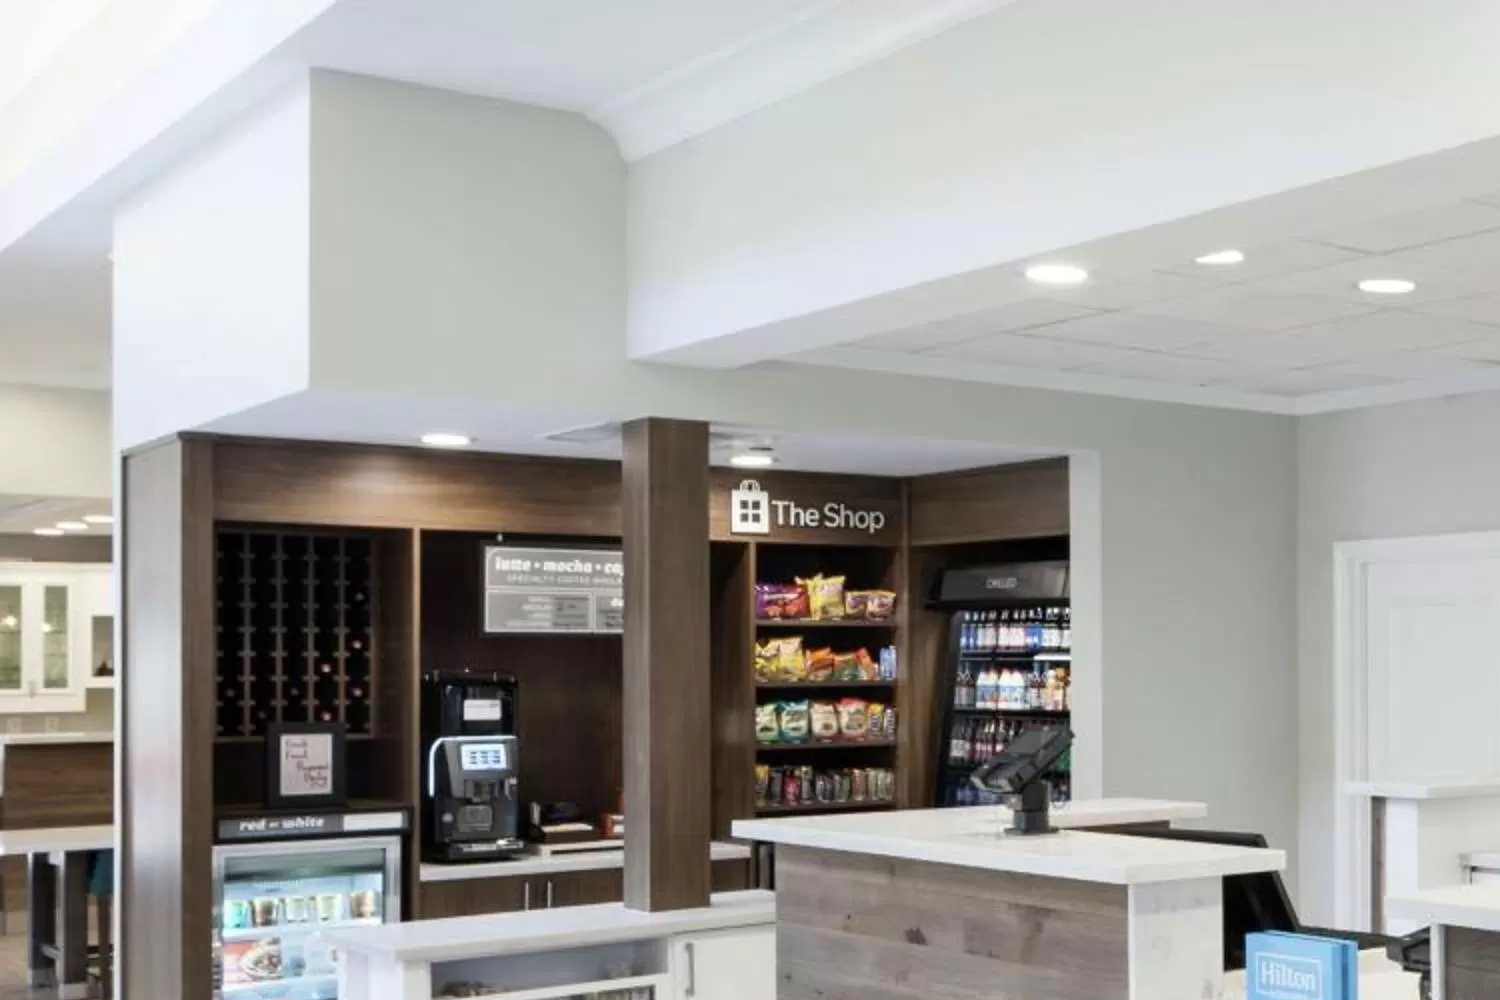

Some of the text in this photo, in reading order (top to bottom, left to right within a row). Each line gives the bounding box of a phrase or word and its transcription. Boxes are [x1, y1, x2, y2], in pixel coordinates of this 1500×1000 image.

[771, 499, 885, 534] The Shop
[543, 559, 593, 574] mocha
[282, 816, 325, 830] white
[1260, 959, 1317, 993] Hilton
